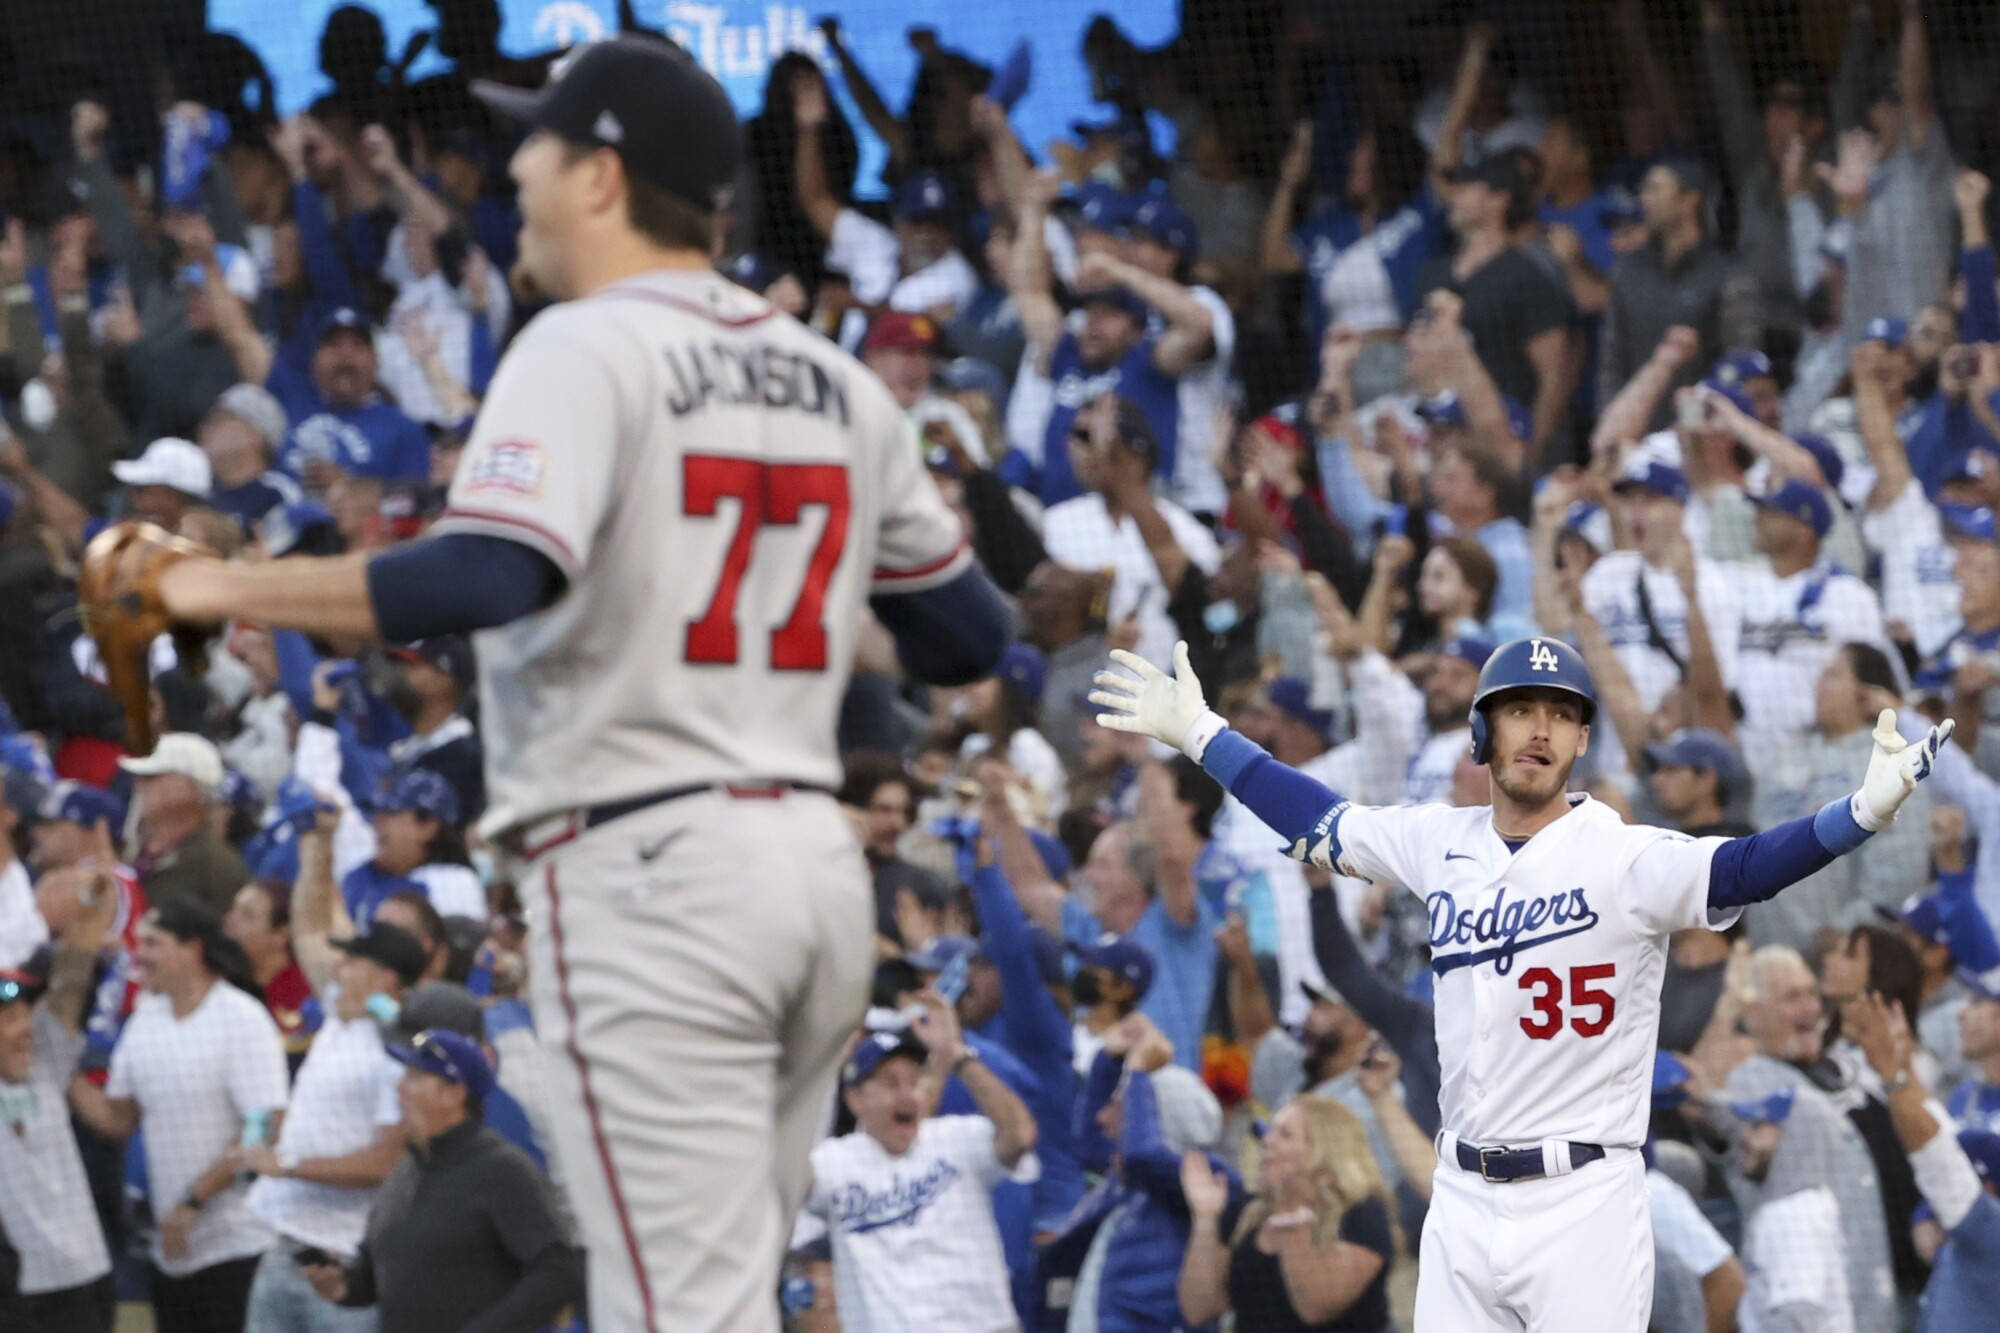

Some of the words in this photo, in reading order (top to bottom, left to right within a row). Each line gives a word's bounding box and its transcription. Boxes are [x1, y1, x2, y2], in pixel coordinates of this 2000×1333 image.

[663, 344, 851, 428] JACKSON
[680, 452, 852, 672] 77
[1529, 639, 1558, 673] LA
[1427, 886, 1599, 979] Dodgers
[1518, 962, 1616, 1040] 35
